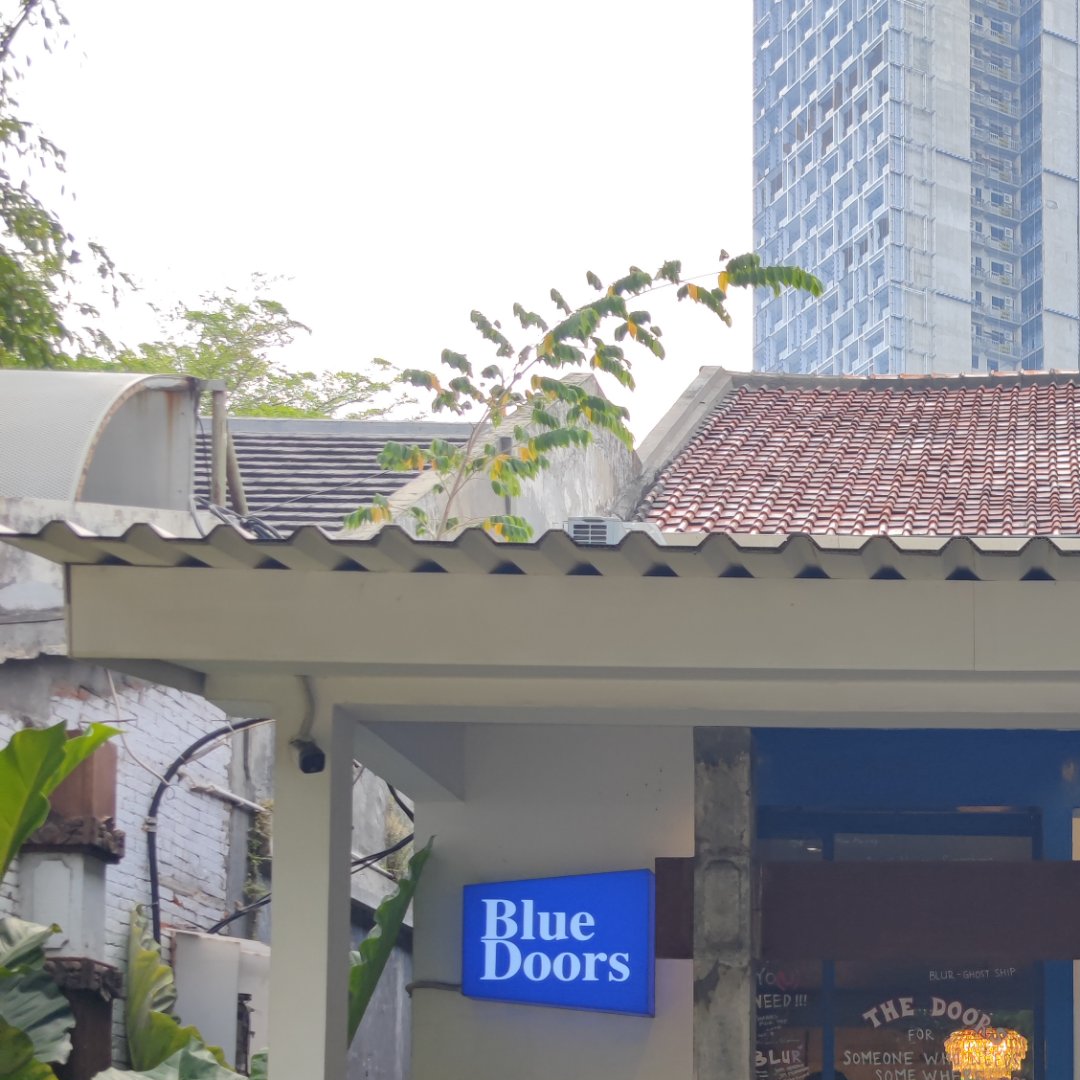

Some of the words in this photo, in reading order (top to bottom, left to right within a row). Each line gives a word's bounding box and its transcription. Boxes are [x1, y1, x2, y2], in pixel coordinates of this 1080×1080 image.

[480, 898, 595, 941] Blue
[480, 939, 631, 982] Doors
[994, 967, 1016, 978] SHIP
[862, 996, 915, 1029] THE
[907, 1028, 935, 1042] FOR
[843, 1050, 914, 1066] SOMEONE
[924, 1051, 960, 1066] WH
